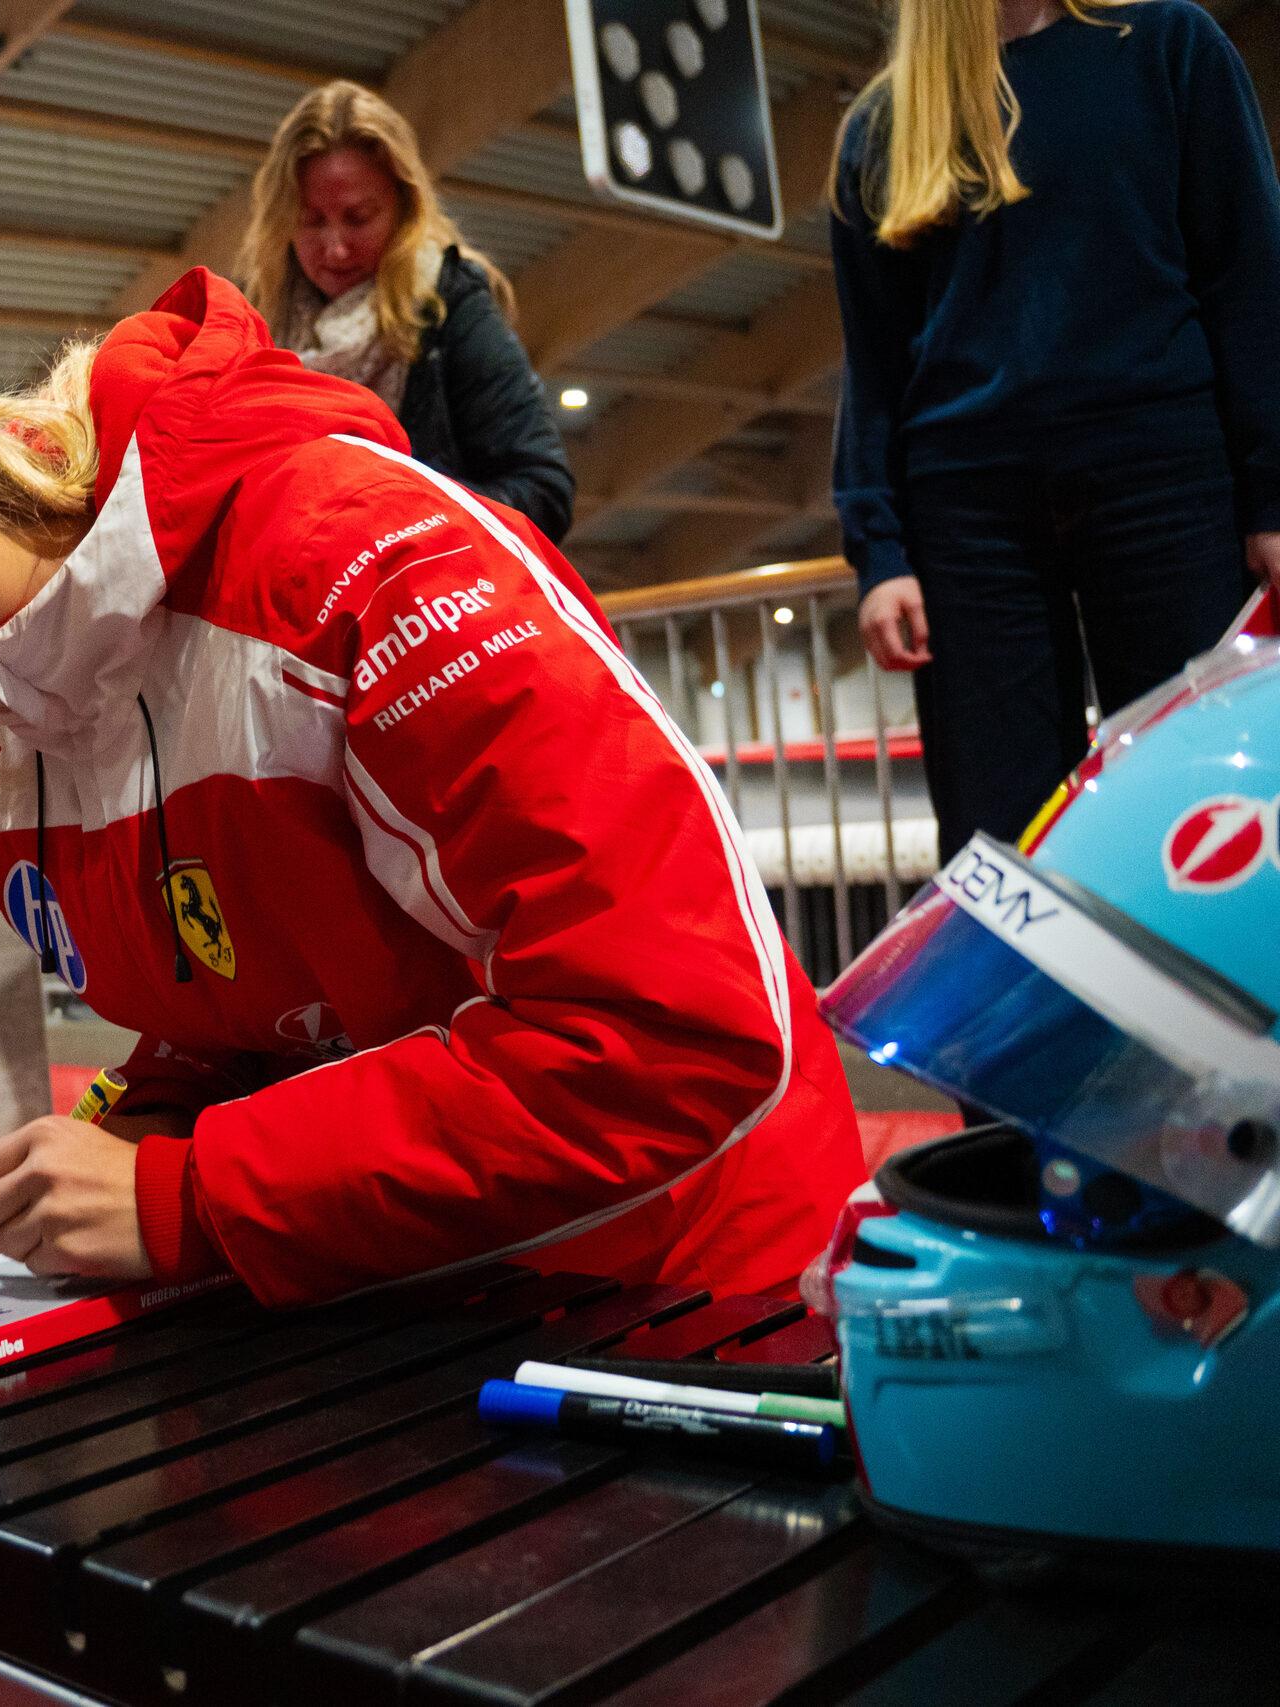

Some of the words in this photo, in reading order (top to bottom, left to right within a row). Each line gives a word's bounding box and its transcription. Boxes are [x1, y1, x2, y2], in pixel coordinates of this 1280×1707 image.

[316, 550, 376, 625] DRIVER
[374, 513, 450, 553] ACADEMY
[353, 585, 492, 692] ambipar
[372, 650, 481, 732] RICHARD
[481, 619, 543, 657] MILLE
[19, 862, 76, 989] hp
[140, 1286, 181, 1308] VERDENS
